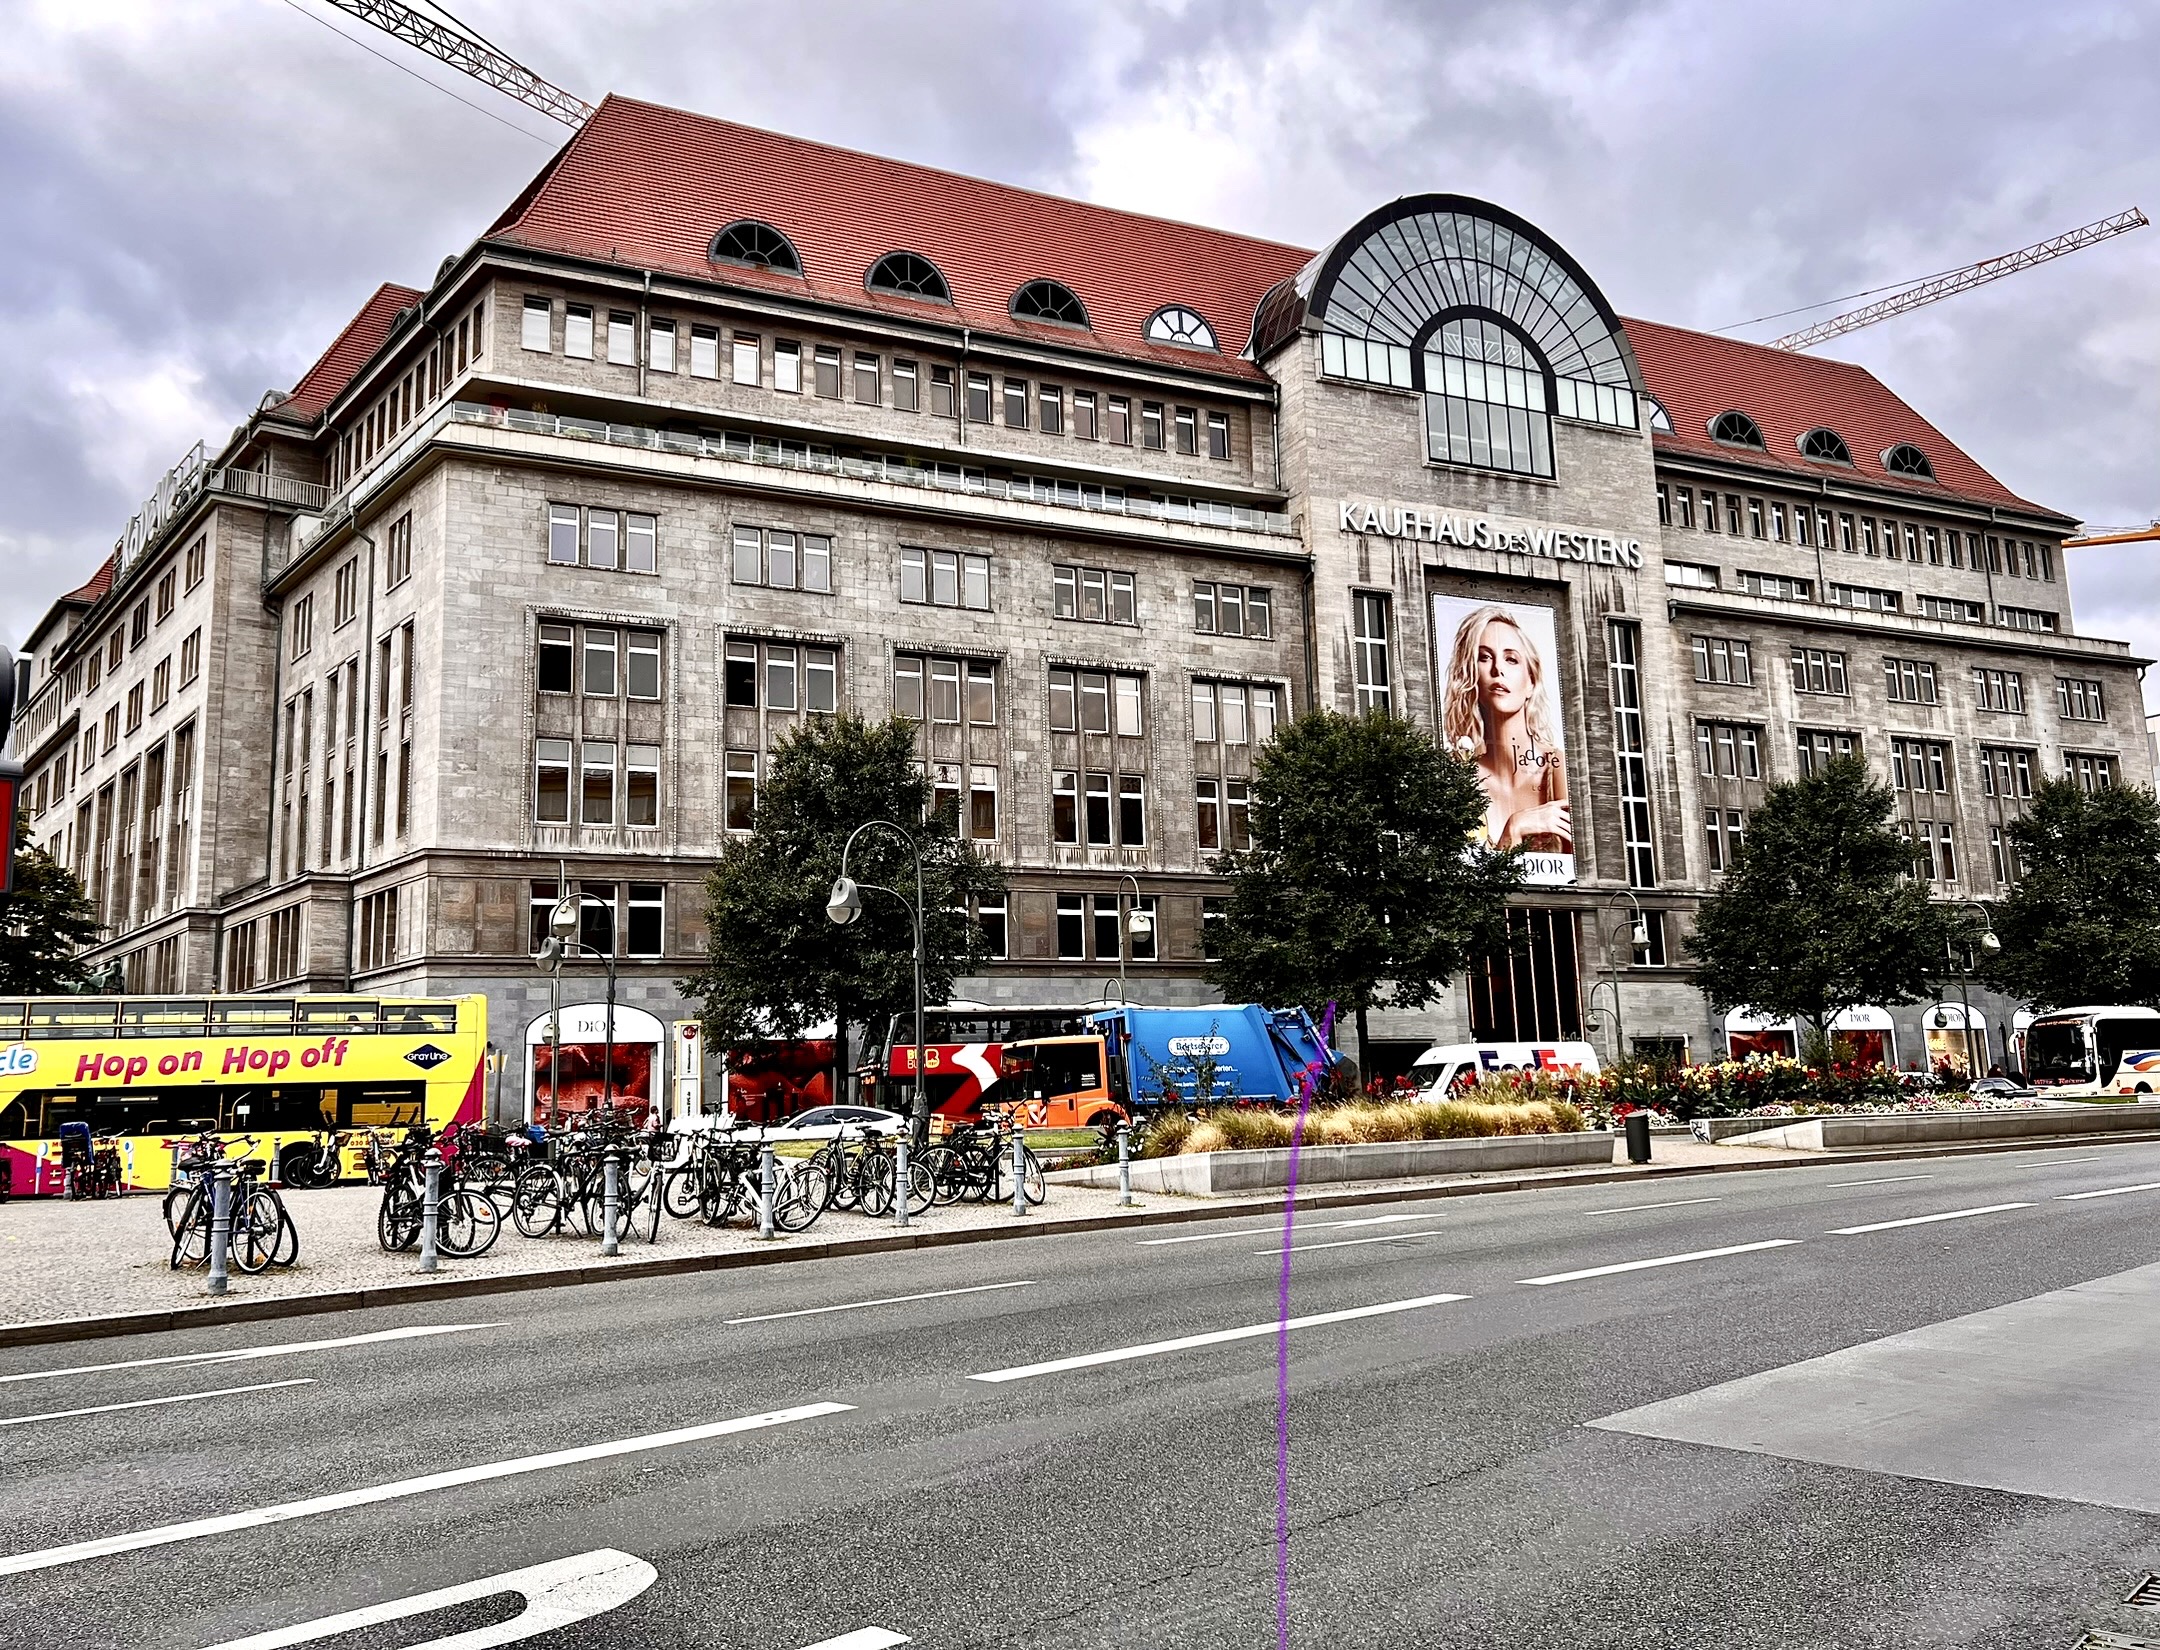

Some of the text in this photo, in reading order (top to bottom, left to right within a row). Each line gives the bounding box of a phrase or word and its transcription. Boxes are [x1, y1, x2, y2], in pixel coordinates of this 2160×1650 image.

[1339, 500, 1643, 568] KAUFHAUS DES WESTENS
[1512, 735, 1560, 775] j'adore
[1523, 858, 1565, 875] DIOR
[1850, 1014, 1870, 1023] DIOR
[74, 1037, 349, 1084] Hop on Hop off
